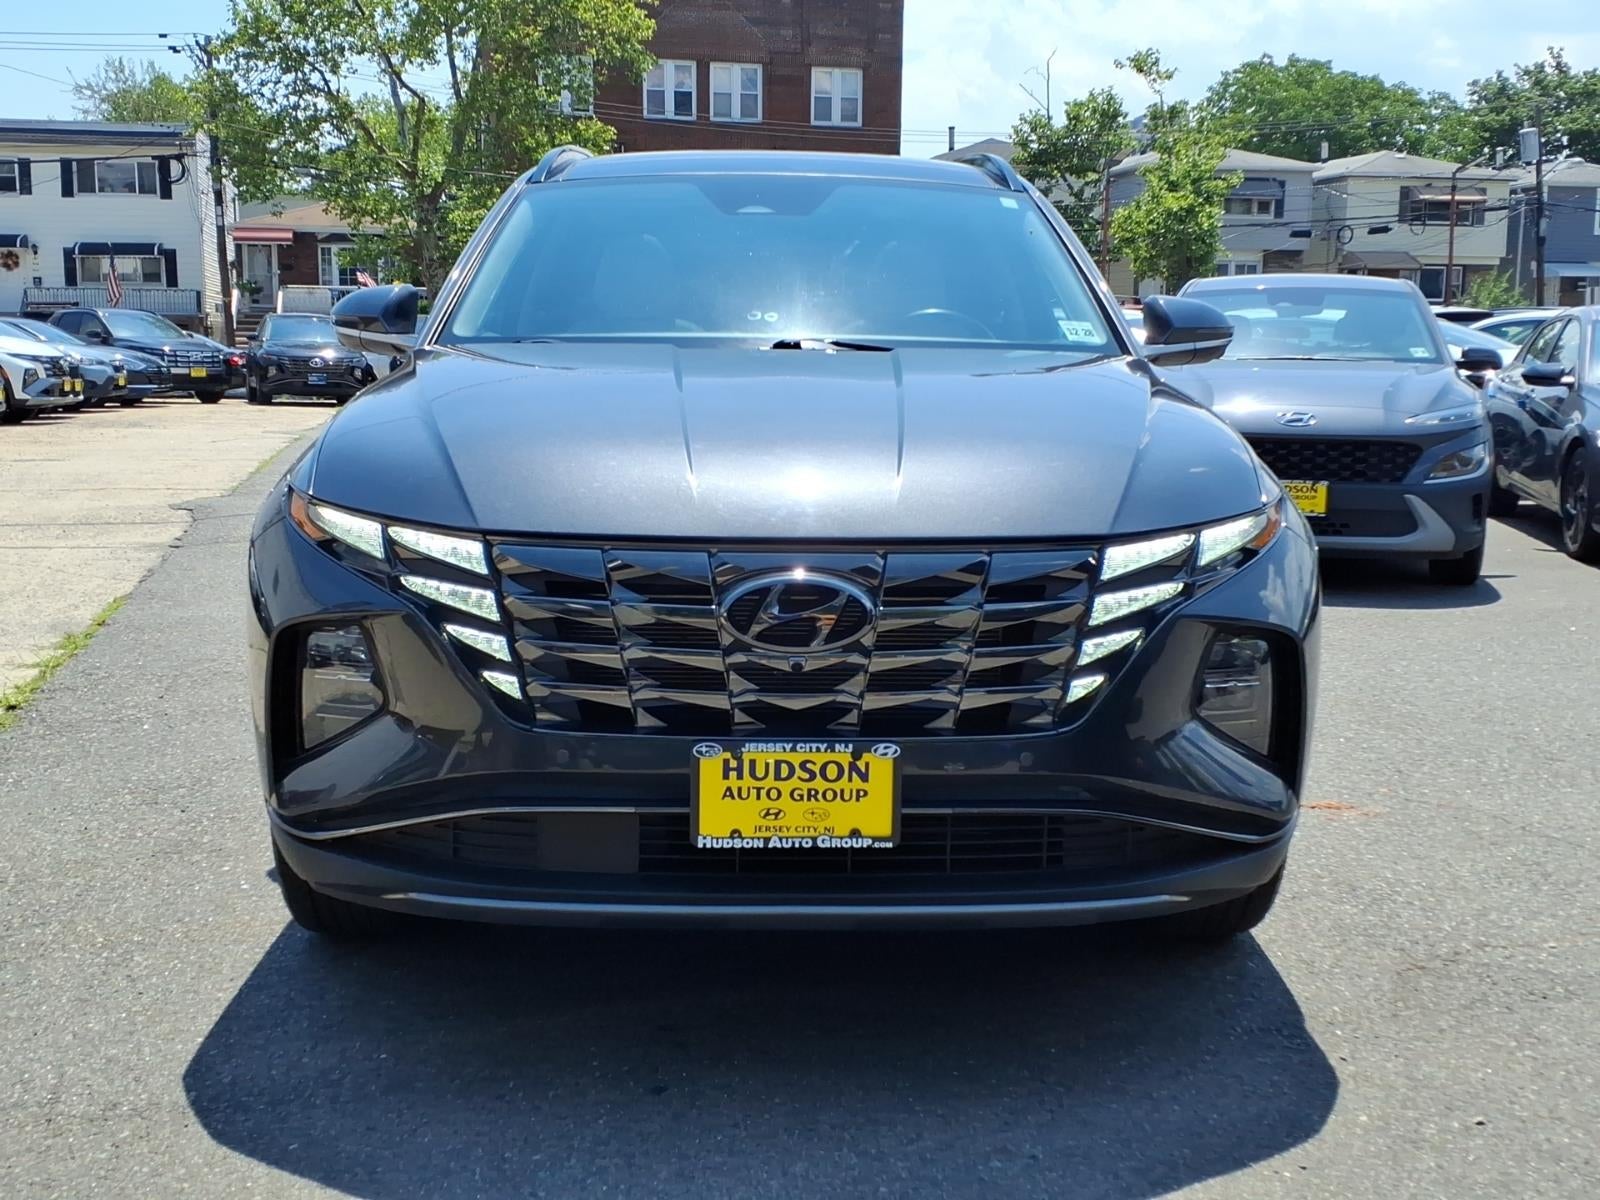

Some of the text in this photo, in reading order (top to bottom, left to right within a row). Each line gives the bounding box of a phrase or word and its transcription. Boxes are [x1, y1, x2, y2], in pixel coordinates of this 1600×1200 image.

[741, 743, 853, 753] JERSEY CITY, NJ
[722, 758, 870, 783] HUDSON
[721, 786, 869, 802] AUTO GROUP
[753, 825, 792, 834] JERSEY
[824, 826, 835, 834] NJ
